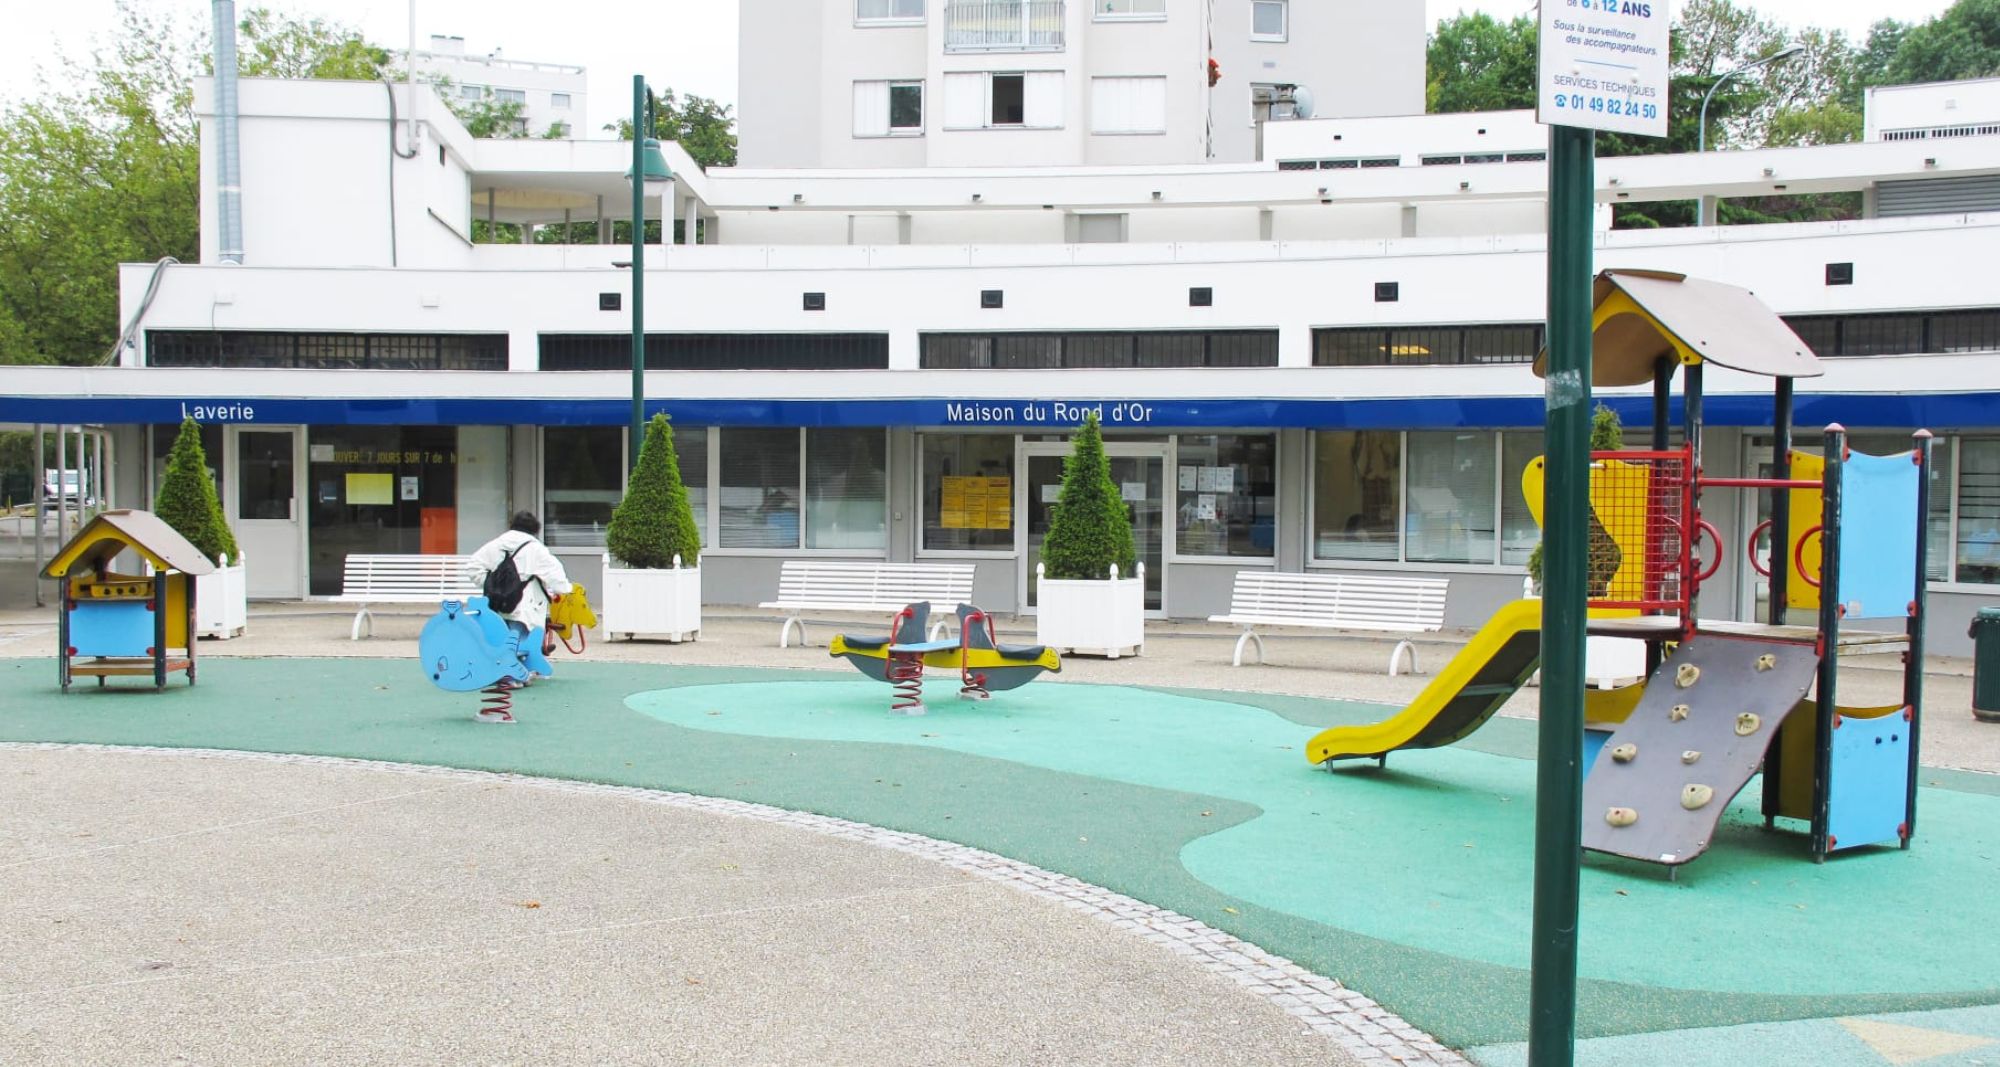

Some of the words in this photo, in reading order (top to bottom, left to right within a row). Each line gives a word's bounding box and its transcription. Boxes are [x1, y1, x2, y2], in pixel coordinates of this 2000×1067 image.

[1581, 0, 1590, 9] 6
[1602, 0, 1617, 12] 12
[1622, 1, 1651, 18] ANS
[1553, 19, 1575, 31] Sous
[1577, 23, 1585, 33] la
[1587, 26, 1636, 40] surveillance
[1565, 34, 1582, 45] des
[1553, 74, 1598, 90] SERVICES
[1601, 81, 1656, 98] TECHNIQUES
[1571, 94, 1585, 110] 01
[1589, 97, 1604, 113] 49
[1607, 99, 1621, 115] 82
[1625, 101, 1639, 117] 24
[1642, 104, 1657, 119] 50
[181, 401, 254, 420] Laverie
[946, 403, 1014, 421] Maison
[1023, 403, 1046, 421] du
[1054, 403, 1103, 421] Rond
[1112, 403, 1153, 421] d'Or
[376, 451, 400, 464] JOURS
[404, 451, 420, 464] SUR
[424, 451, 430, 464] 7
